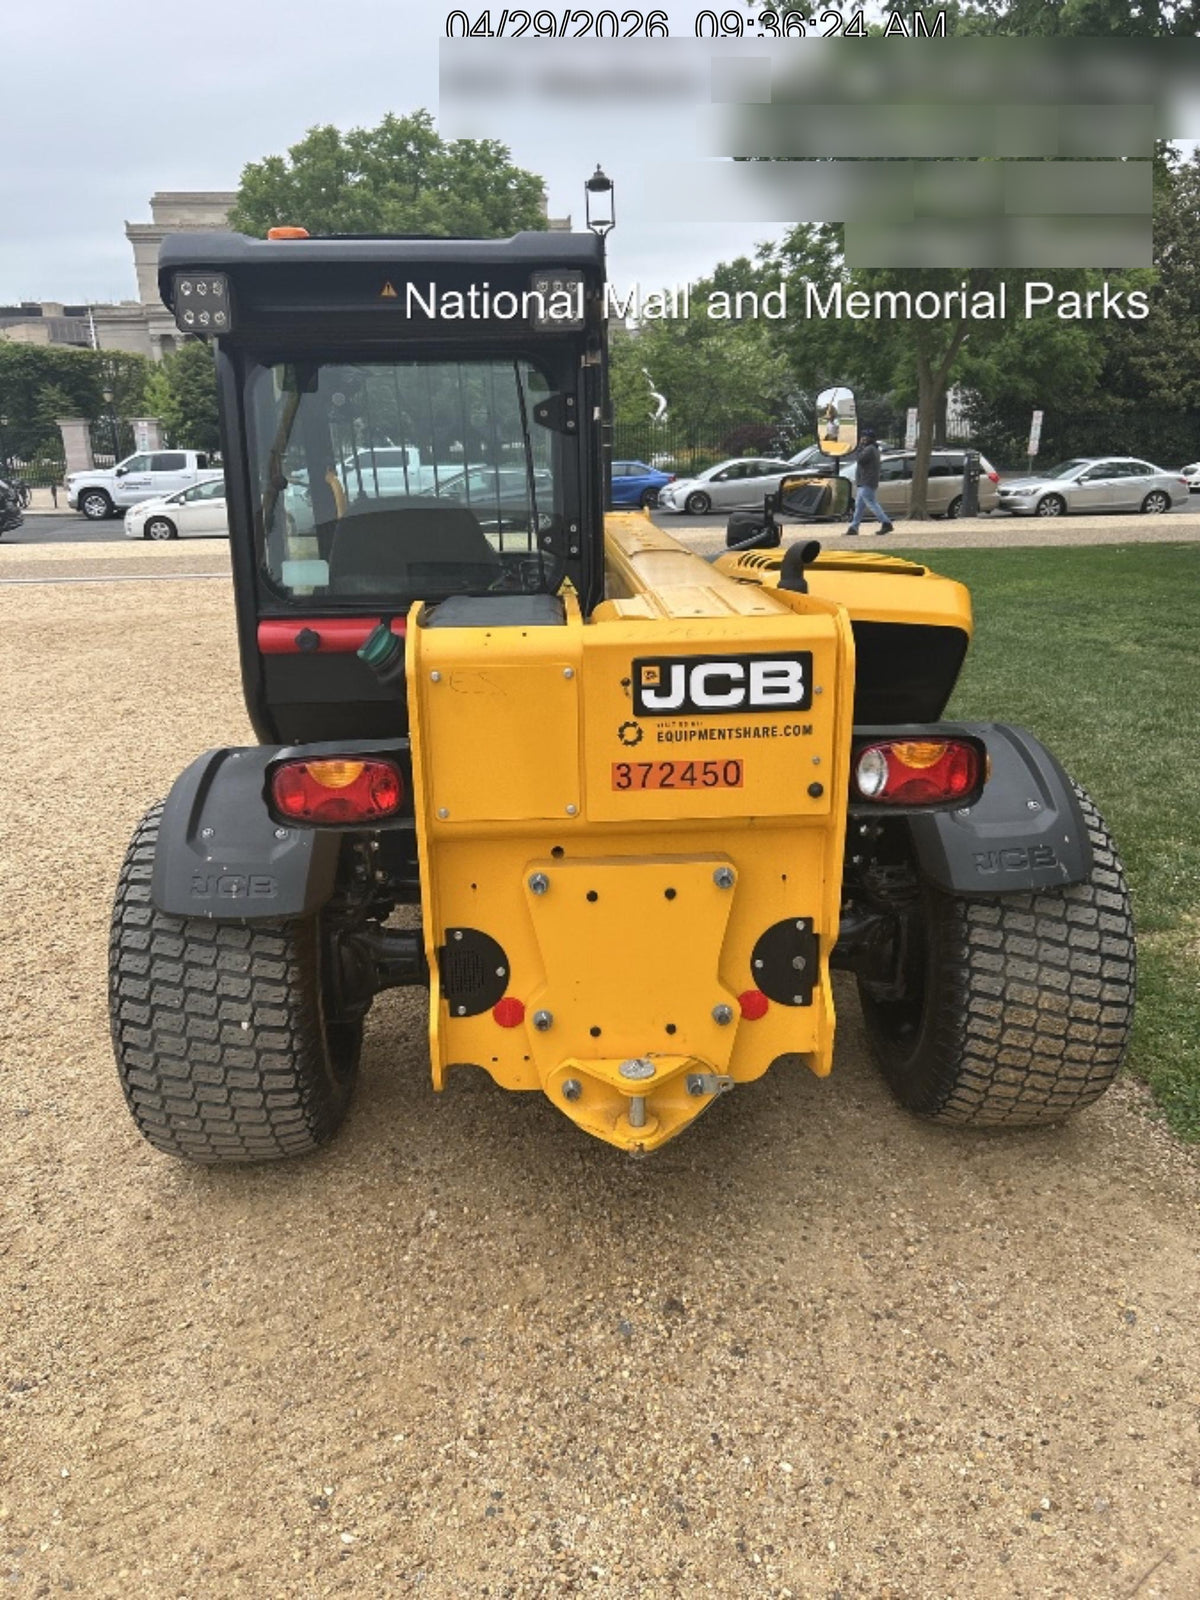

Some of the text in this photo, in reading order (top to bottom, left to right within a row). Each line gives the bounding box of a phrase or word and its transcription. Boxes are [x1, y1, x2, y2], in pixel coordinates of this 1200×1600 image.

[640, 660, 805, 708] JCB
[656, 724, 813, 743] EQUIPMENTSHARE.COM
[615, 760, 741, 790] 372450
[972, 845, 1059, 874] JCB
[190, 874, 279, 899] JCB
